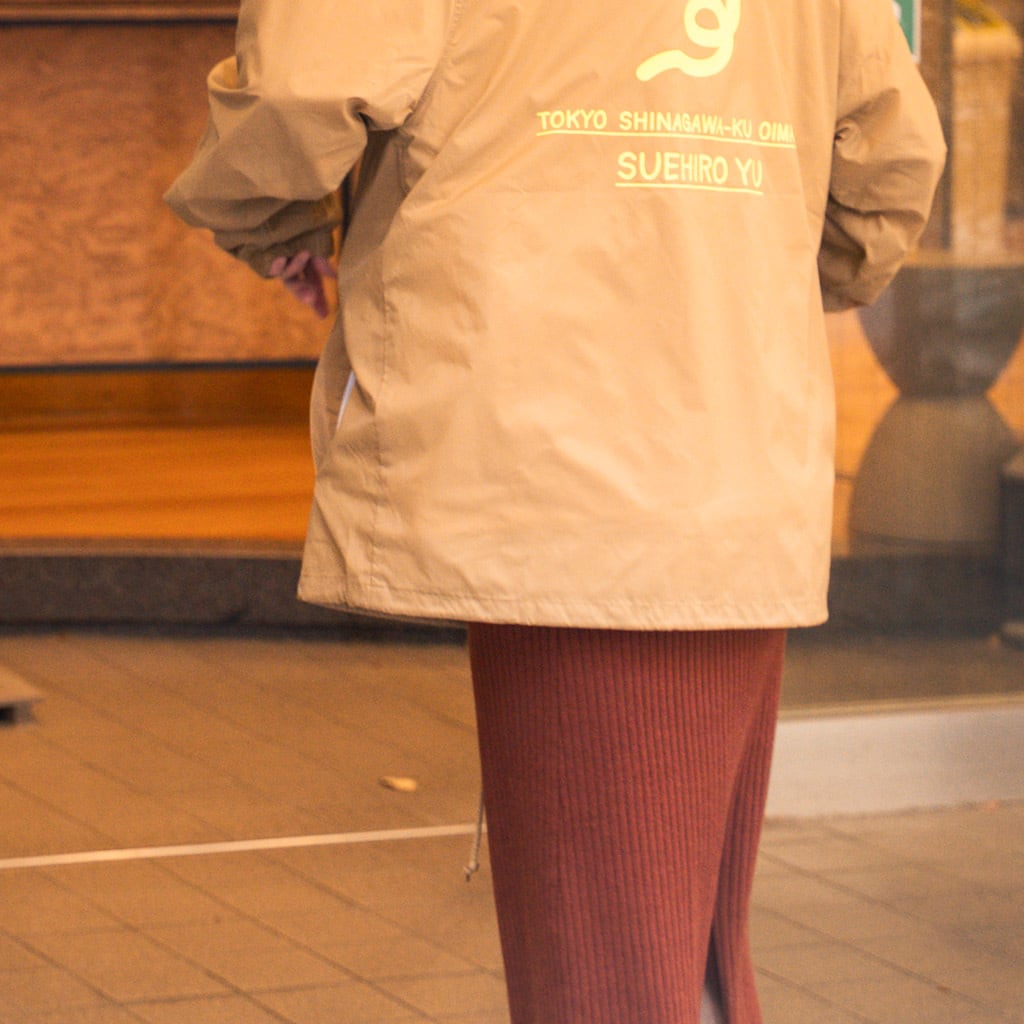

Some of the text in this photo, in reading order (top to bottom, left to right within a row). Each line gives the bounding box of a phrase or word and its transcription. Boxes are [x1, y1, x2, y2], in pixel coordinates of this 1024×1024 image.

[537, 109, 608, 131] TOKYO
[619, 111, 753, 139] SHINAGAWA-KU
[617, 150, 763, 188] SUEHIRO YU
